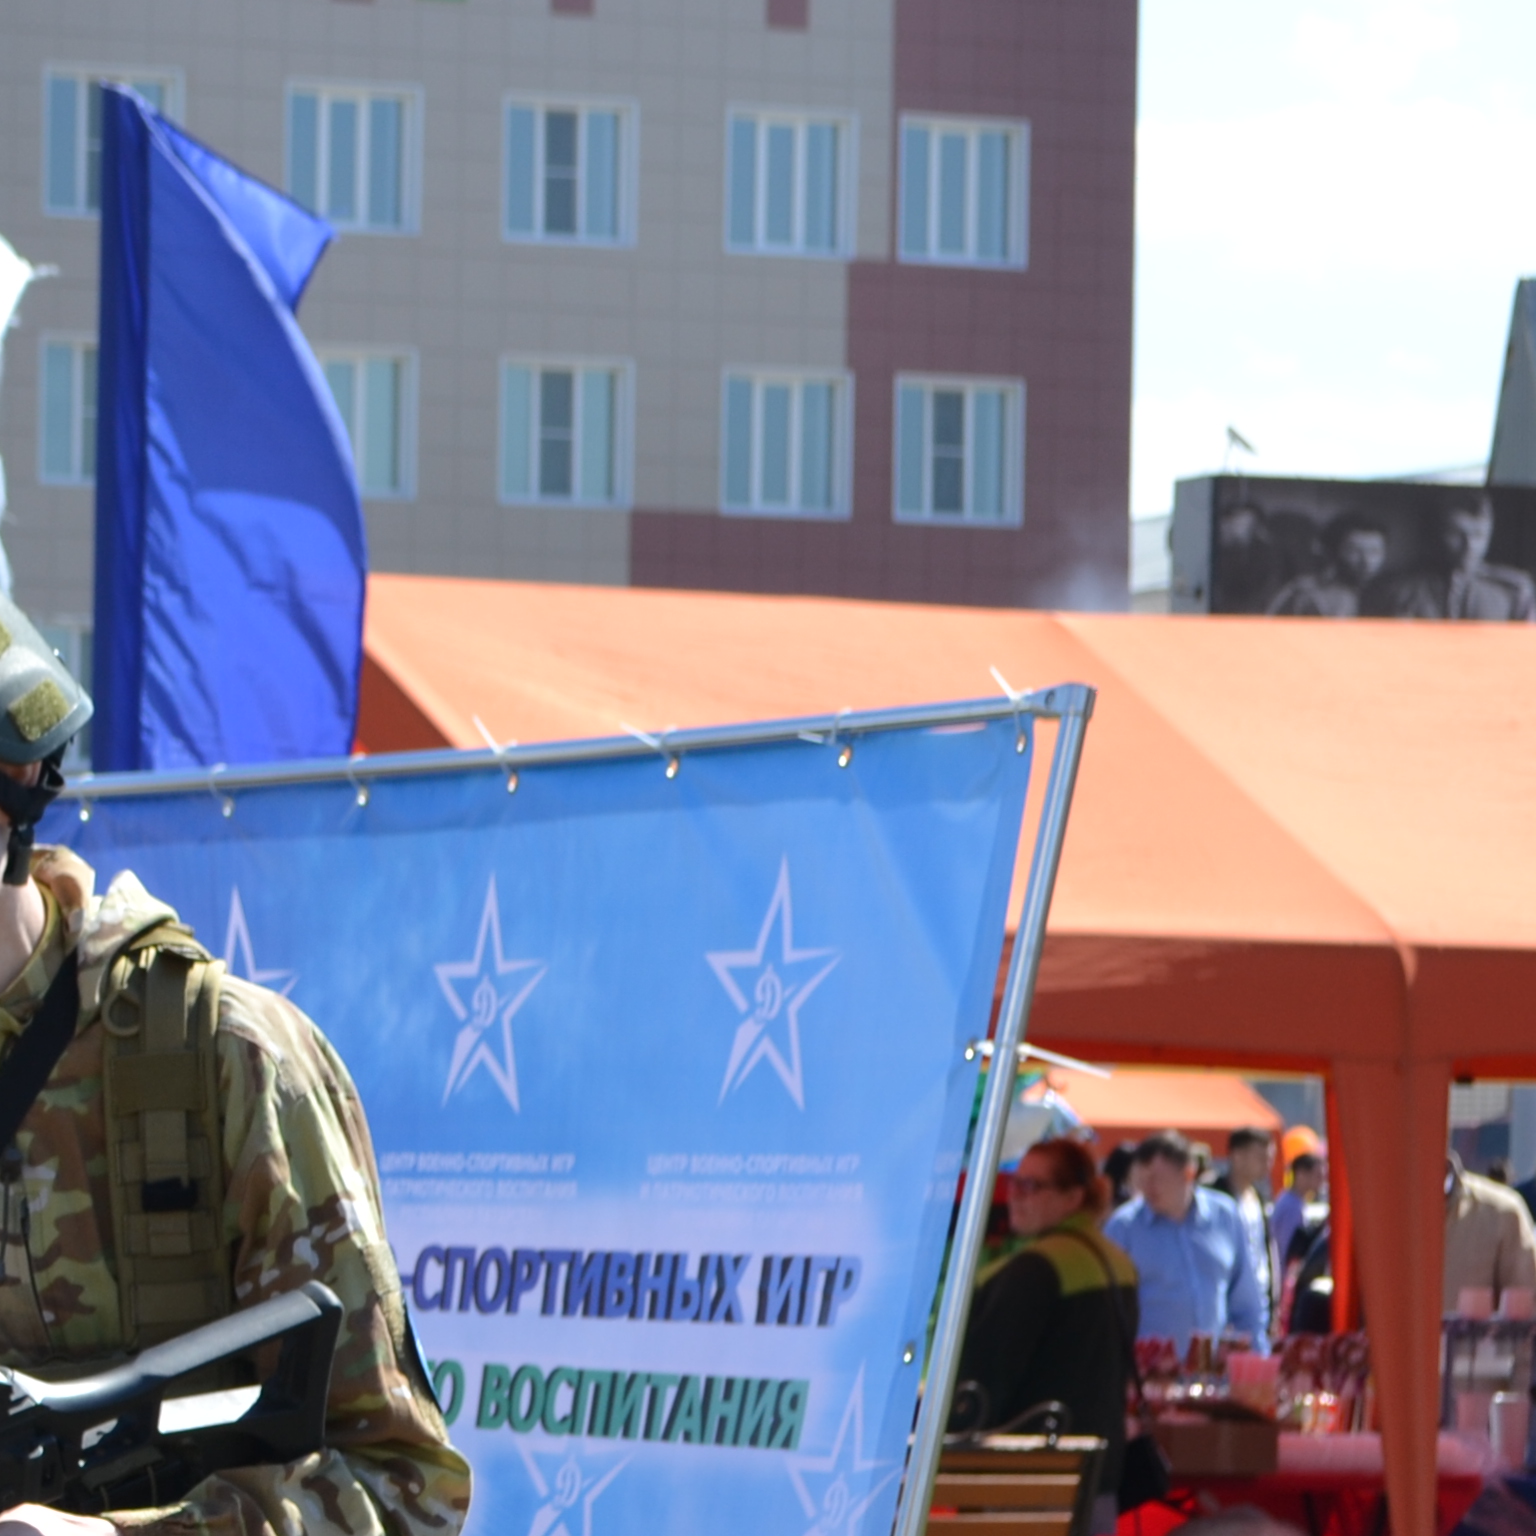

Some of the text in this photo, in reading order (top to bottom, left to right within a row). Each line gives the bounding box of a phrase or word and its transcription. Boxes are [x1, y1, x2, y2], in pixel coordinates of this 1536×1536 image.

[392, 1245, 862, 1328] -СПОРТИВНЫХ ИГР
[476, 1363, 809, 1450] ВОСПИТАНИЯ
